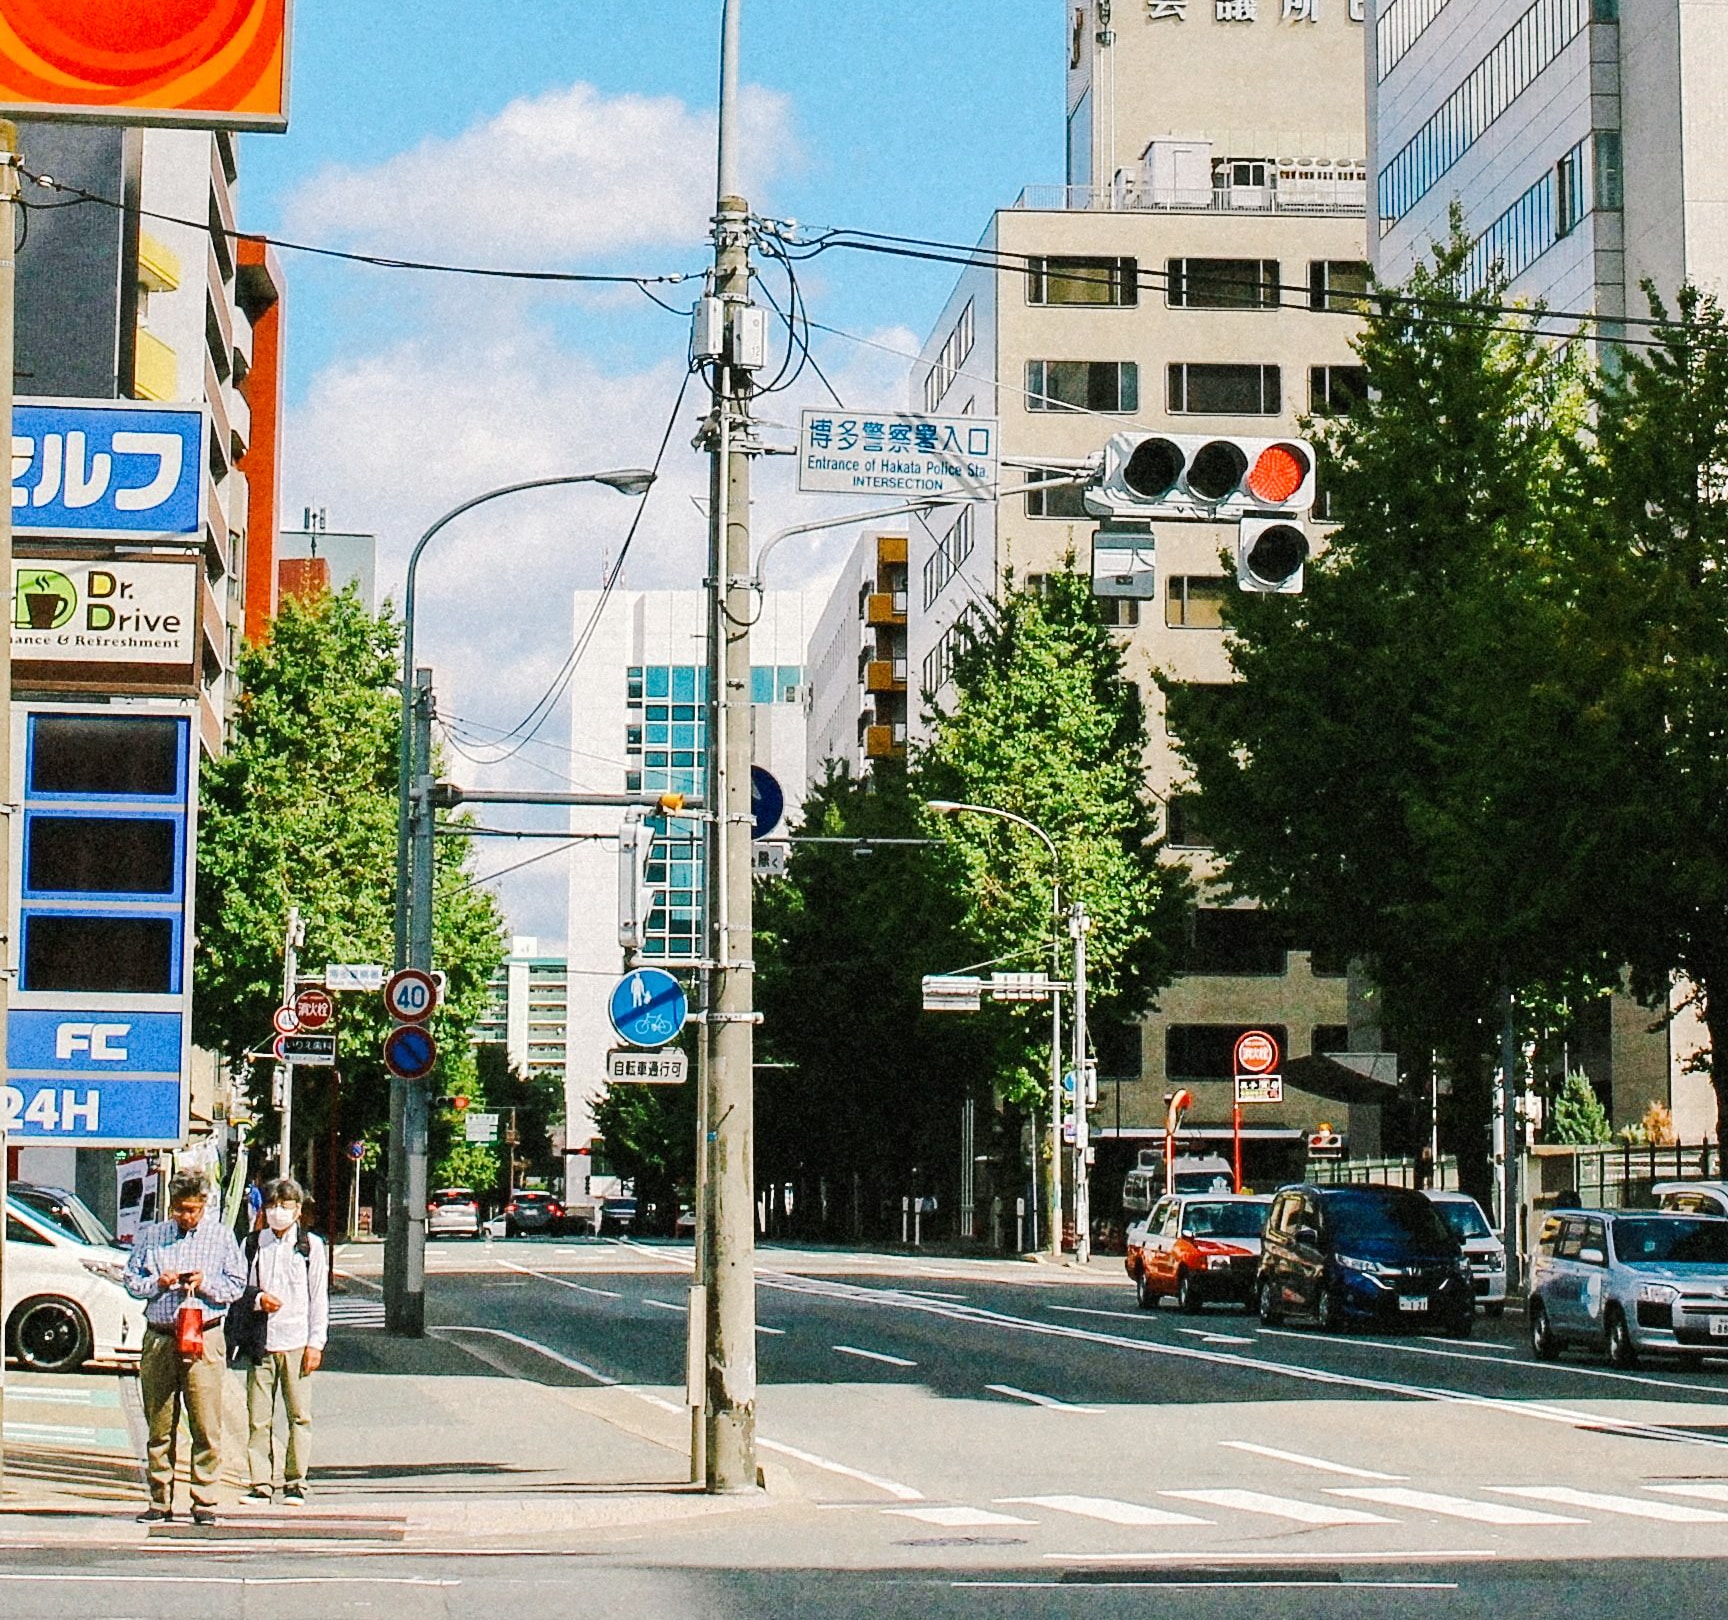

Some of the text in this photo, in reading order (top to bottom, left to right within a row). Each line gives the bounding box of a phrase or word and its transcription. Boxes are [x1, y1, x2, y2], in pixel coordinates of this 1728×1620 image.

[810, 417, 989, 455] 博多警察署入口
[808, 455, 989, 479] Entrance of Hakata Police Sta.
[853, 476, 943, 490] INTERSECTION
[88, 571, 134, 599] Dr.
[86, 604, 181, 633] Drive
[57, 635, 69, 646] &
[75, 635, 181, 648] Refreshment
[397, 985, 425, 1008] 40
[298, 1002, 327, 1017] 消火栓
[55, 1022, 133, 1061] FC
[614, 1060, 682, 1078] 自転車通行可
[7, 1088, 100, 1132] 24H
